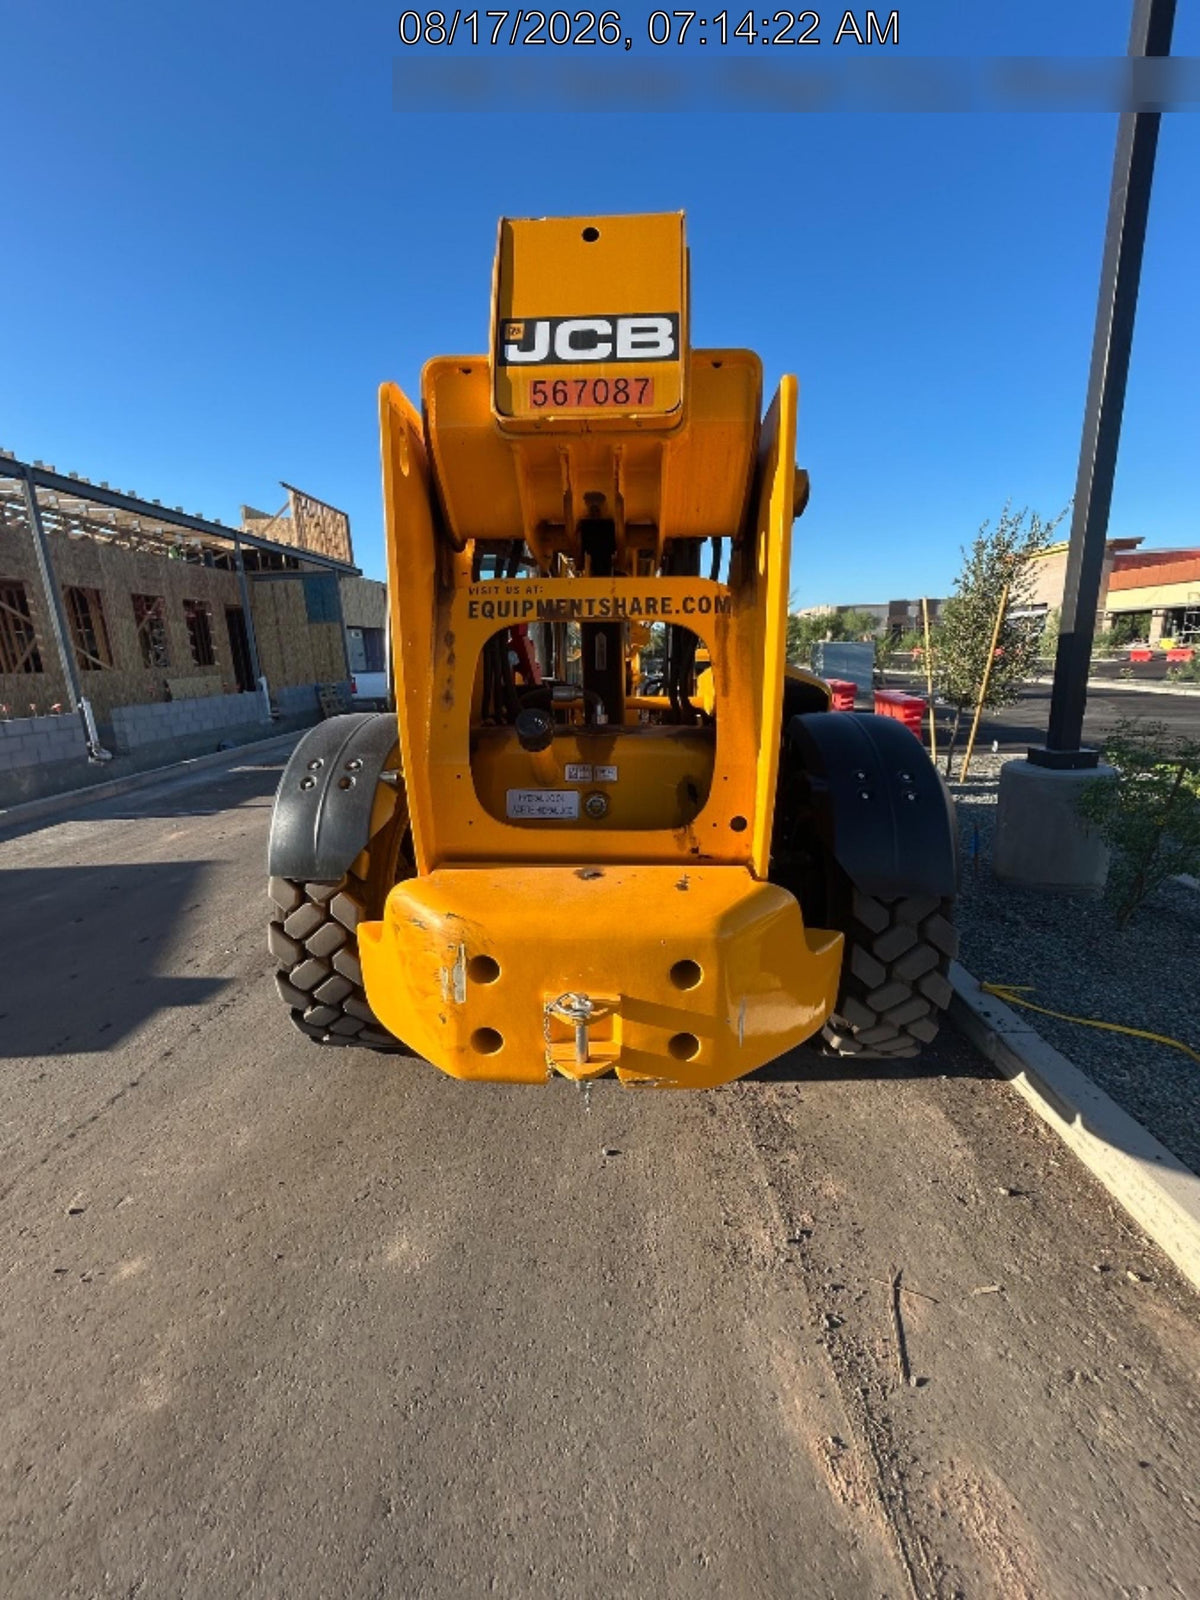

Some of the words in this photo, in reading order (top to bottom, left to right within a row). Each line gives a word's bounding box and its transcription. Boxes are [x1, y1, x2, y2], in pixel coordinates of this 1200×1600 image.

[504, 317, 675, 362] JCB
[532, 377, 650, 407] 567087
[468, 586, 499, 595] VISIT
[506, 586, 520, 595] US
[526, 585, 543, 595] AT:
[468, 596, 731, 619] EQUIPMENTSHARE.COM
